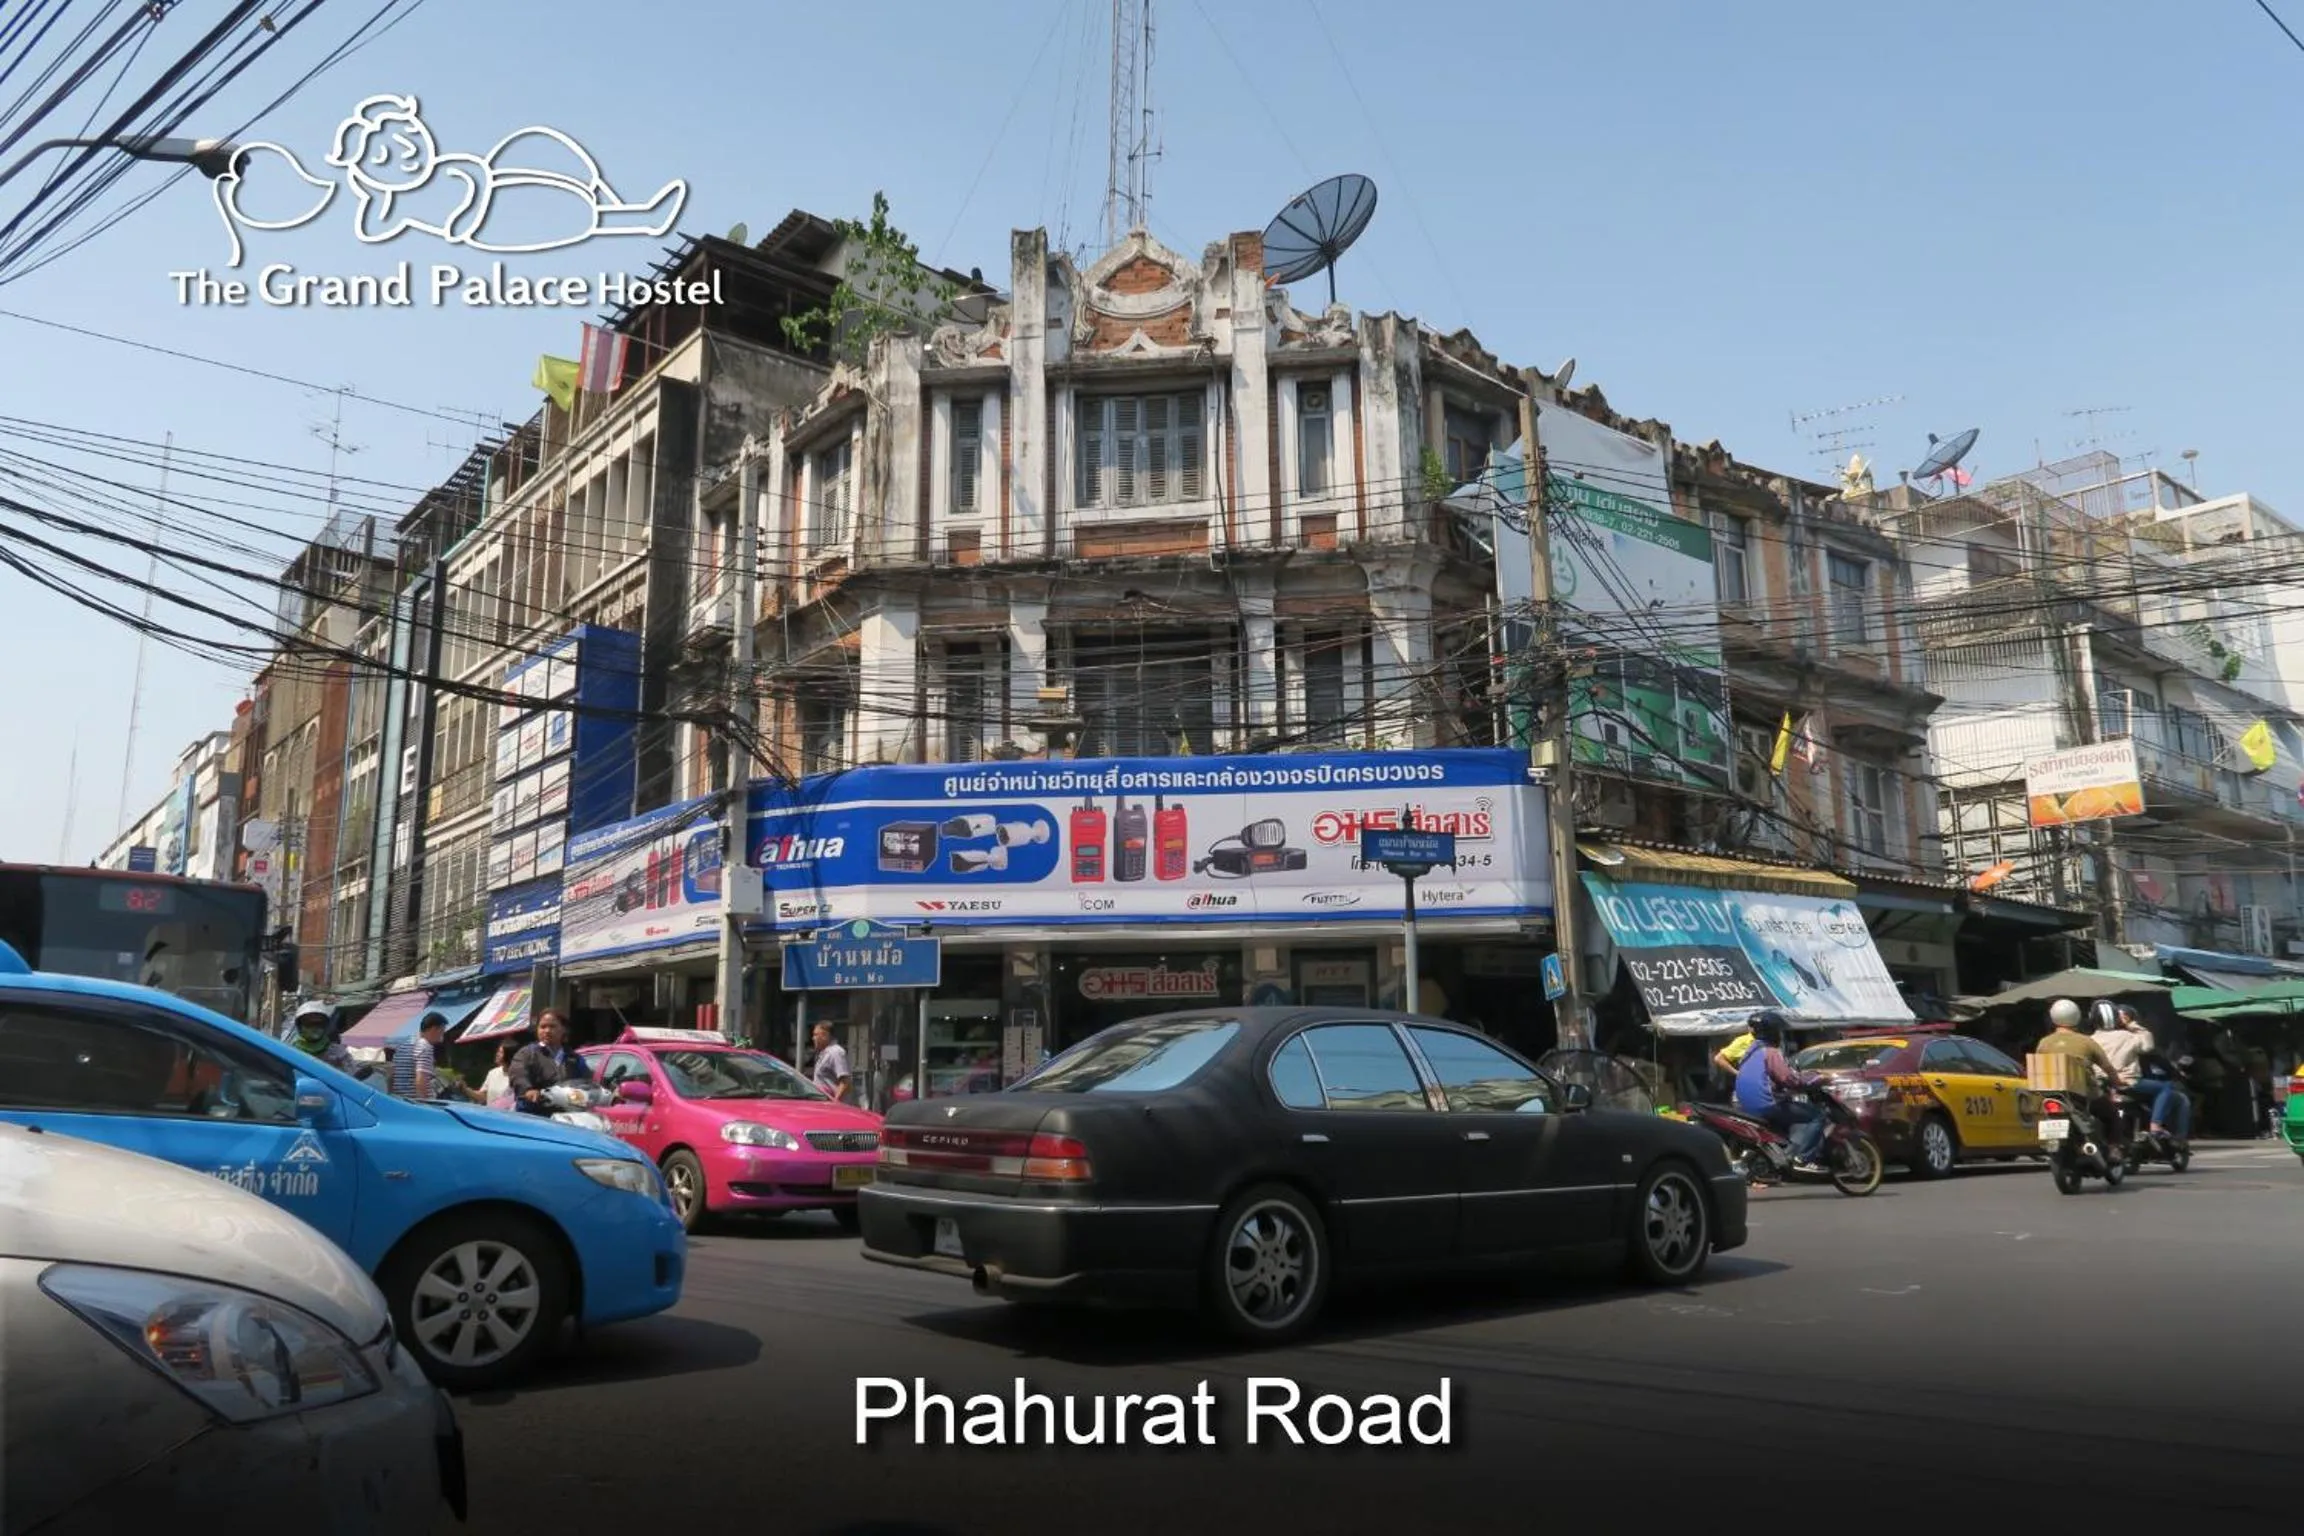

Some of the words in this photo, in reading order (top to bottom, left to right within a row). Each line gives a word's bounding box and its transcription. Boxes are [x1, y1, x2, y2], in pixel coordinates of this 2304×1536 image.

[948, 900, 1003, 911] YAESU
[1422, 890, 1464, 906] Hytera
[816, 943, 903, 968] บ้านหม้อ
[835, 973, 858, 984] Ban
[1965, 1096, 1995, 1116] 2131
[922, 1134, 969, 1146] CEFIRO
[270, 1164, 319, 1195] จำกัด
